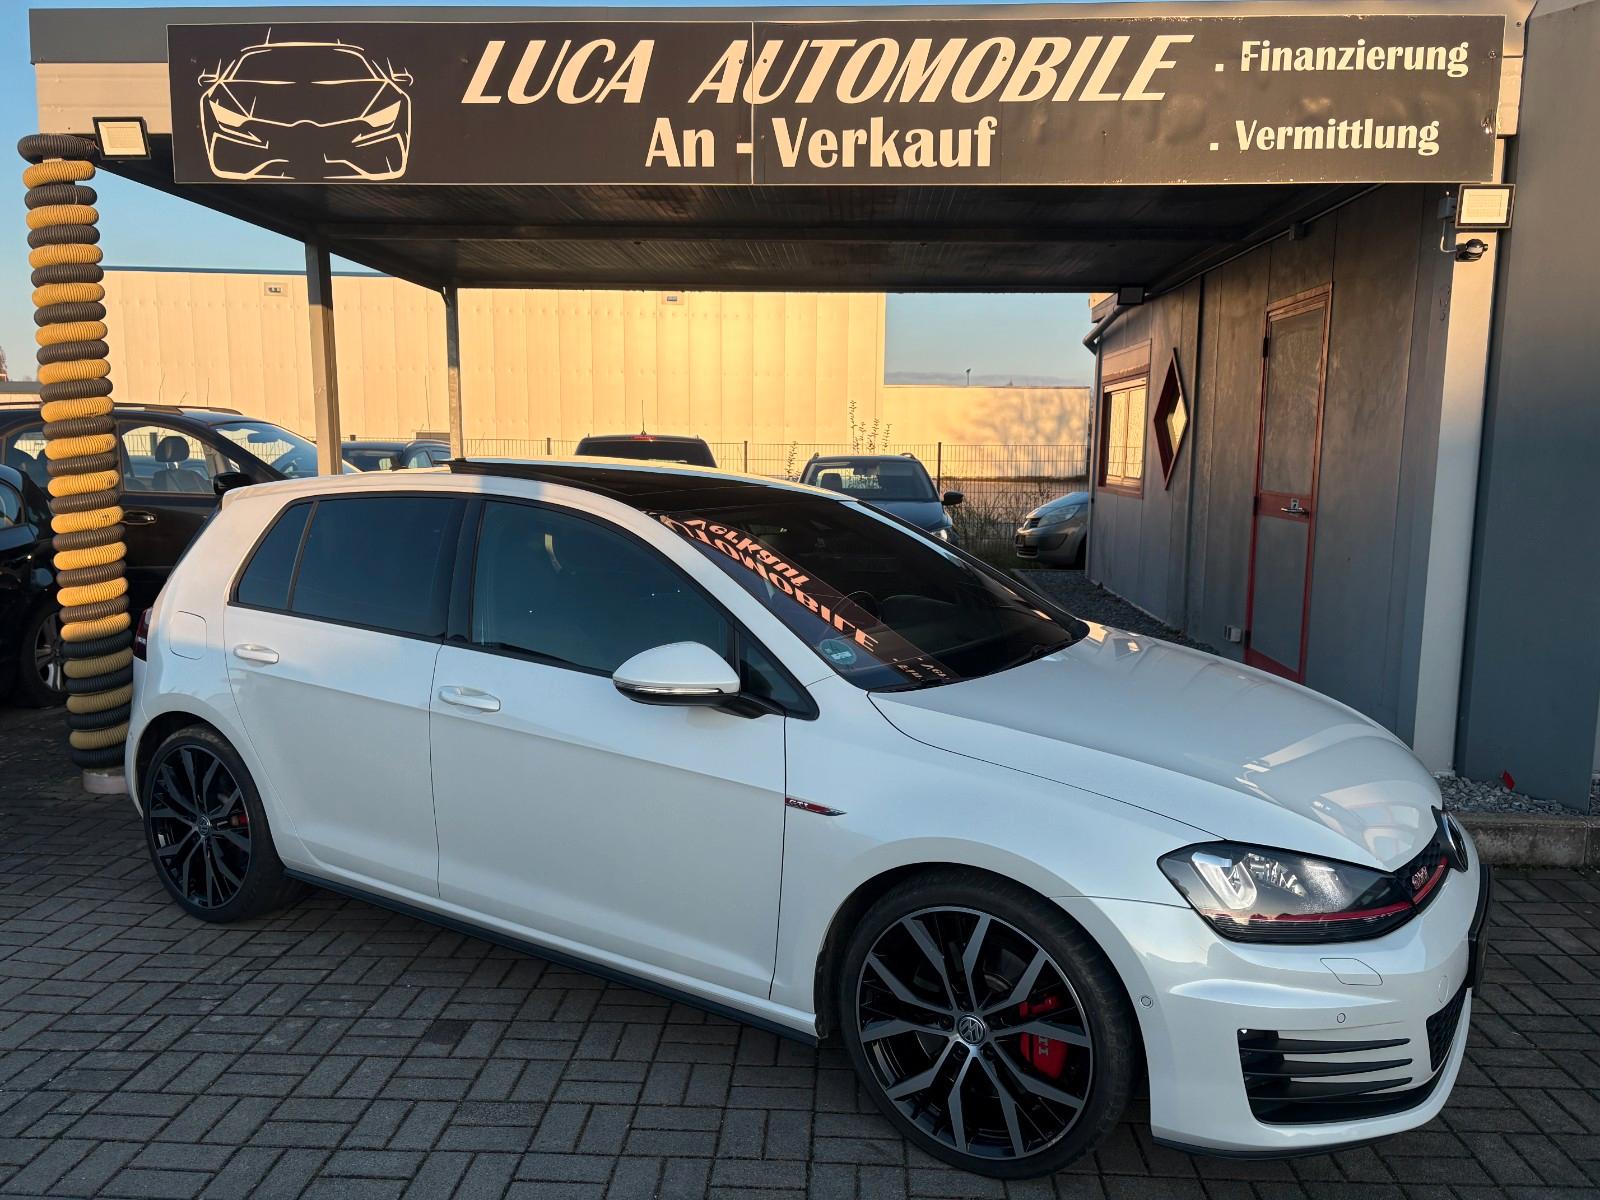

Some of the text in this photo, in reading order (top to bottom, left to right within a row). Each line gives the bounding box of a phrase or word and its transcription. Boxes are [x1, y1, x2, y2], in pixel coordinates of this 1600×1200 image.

[461, 34, 1195, 105] LUCA AUTOMOBILE
[1240, 38, 1469, 78] Finanzierung
[645, 117, 715, 167] An
[771, 116, 998, 168] Verkauf
[1235, 118, 1440, 156] Vermittlung
